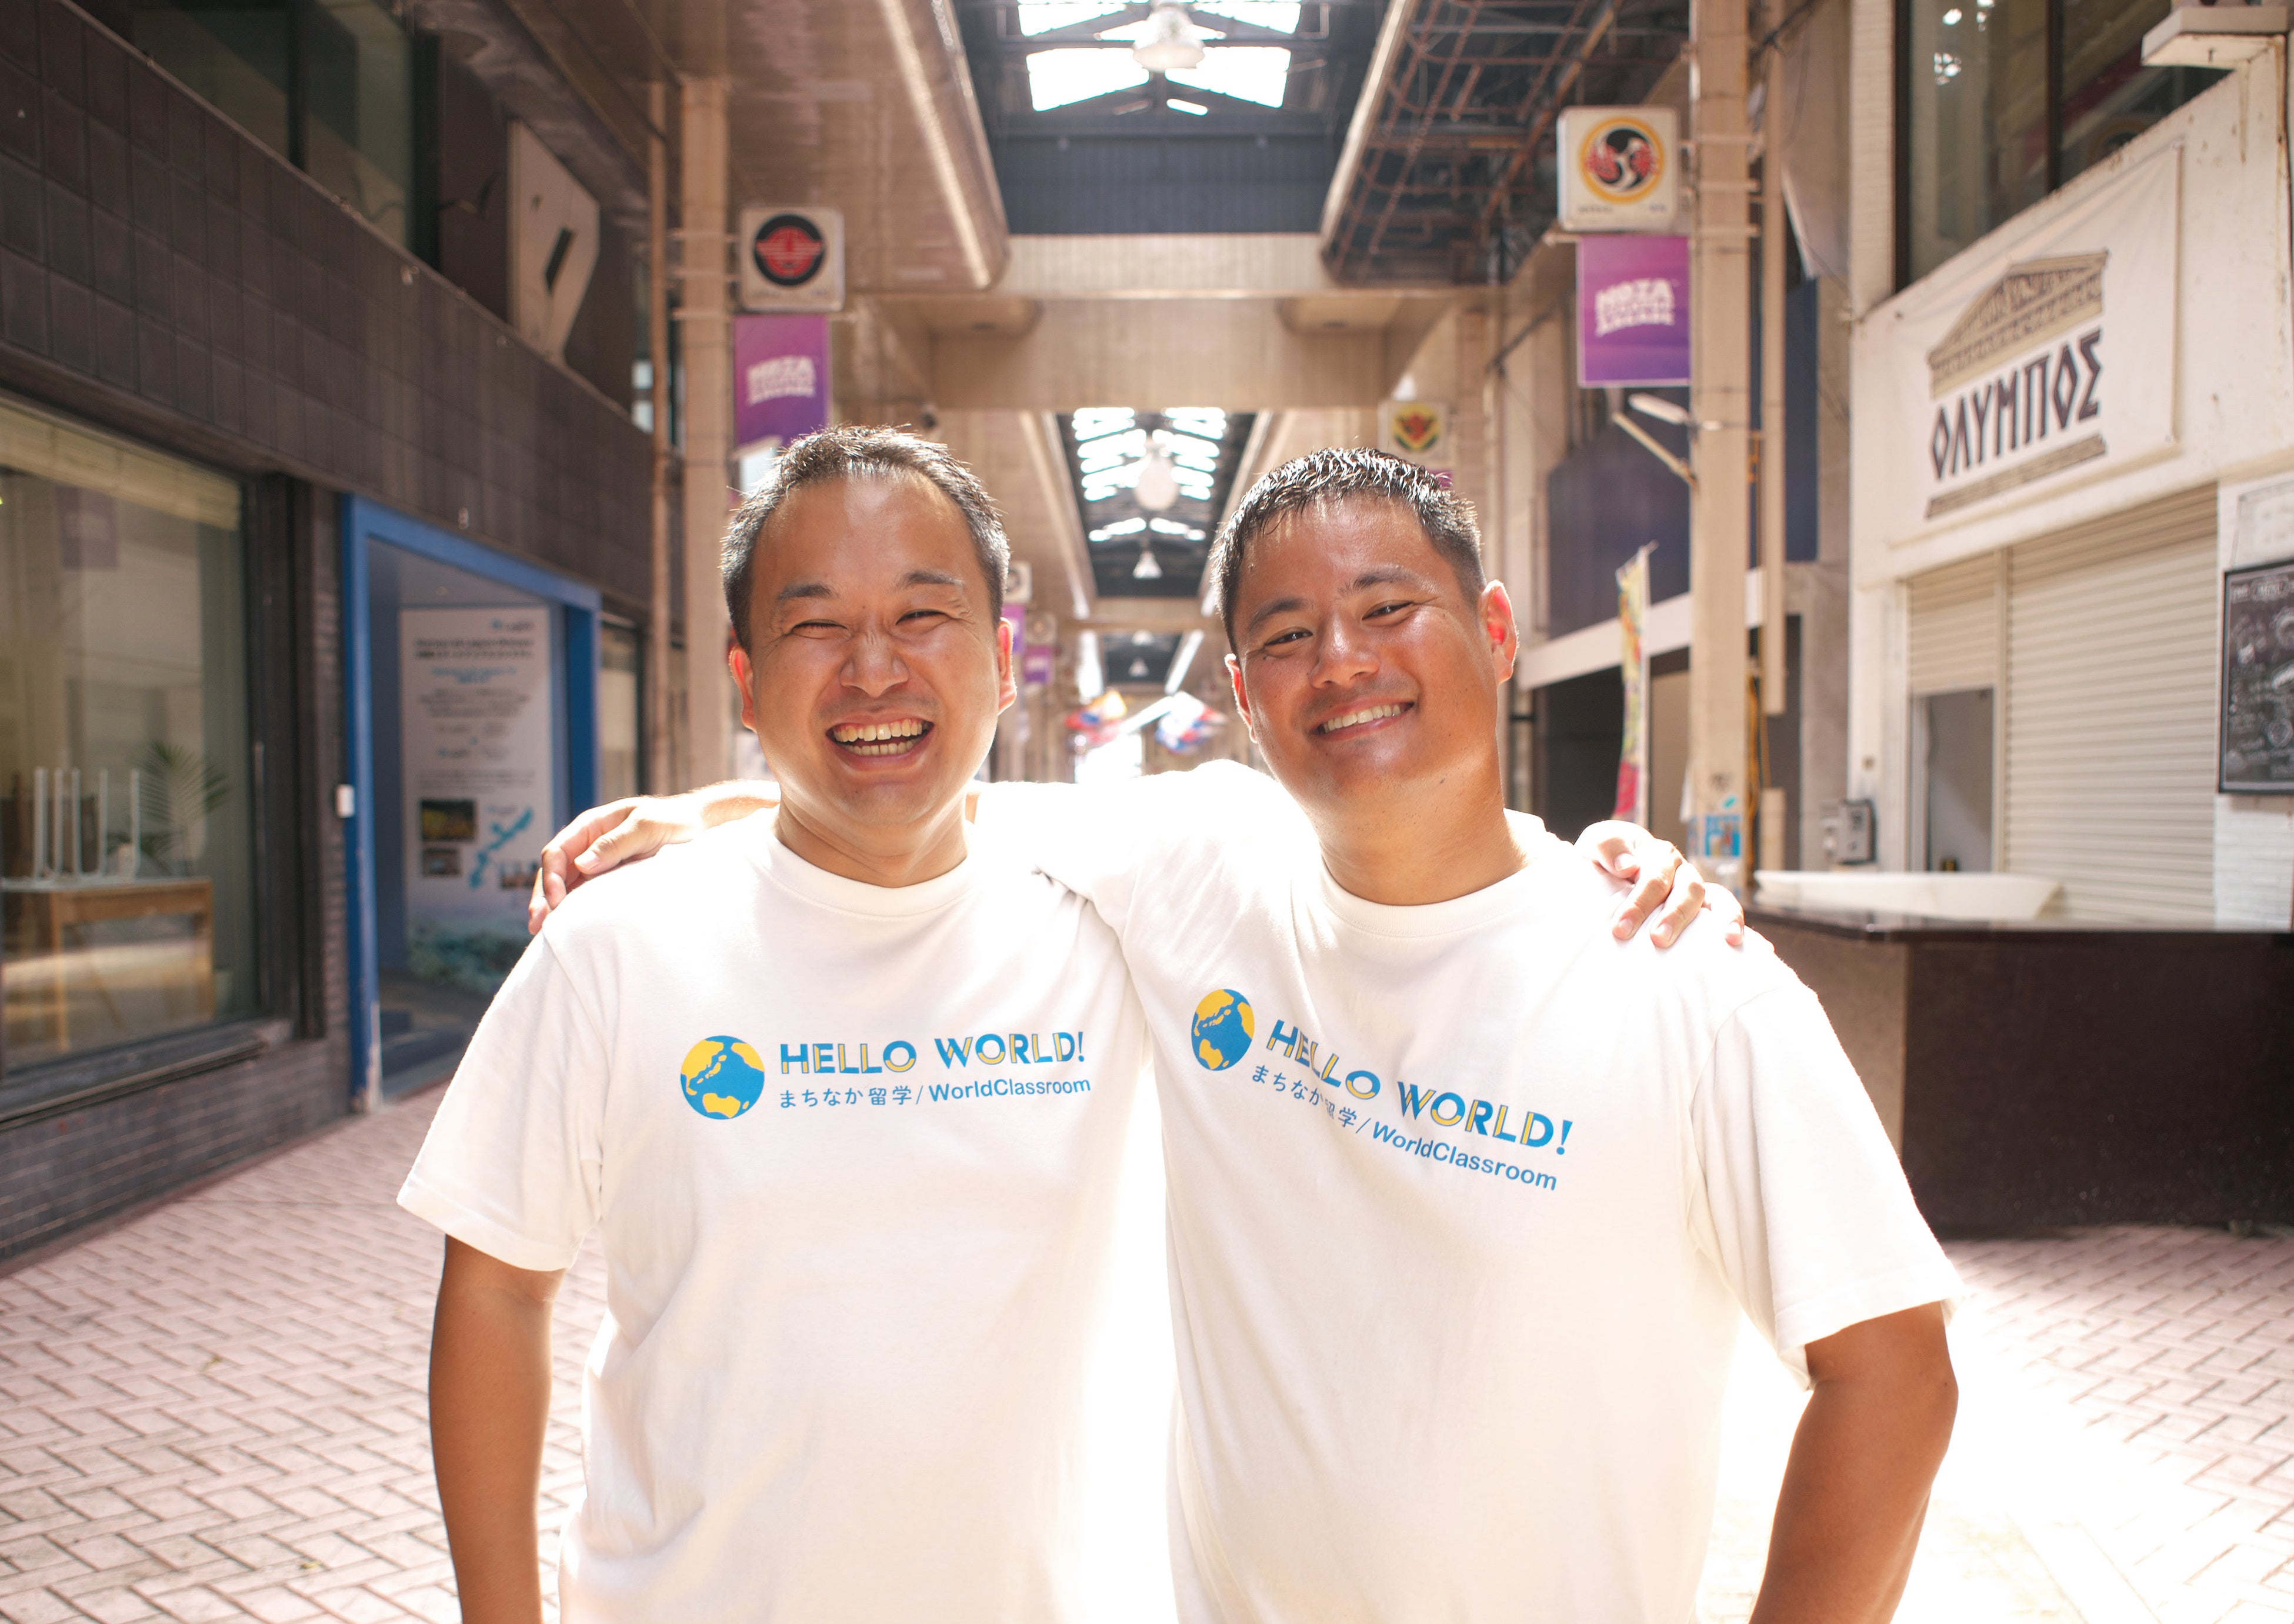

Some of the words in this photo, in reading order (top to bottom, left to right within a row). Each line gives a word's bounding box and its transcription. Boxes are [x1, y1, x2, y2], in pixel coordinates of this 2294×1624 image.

[780, 1040, 917, 1075] HELLO
[934, 1031, 1085, 1069] WORLD!
[1266, 1019, 1382, 1099] HELLO
[1396, 1081, 1573, 1156] WORLD!
